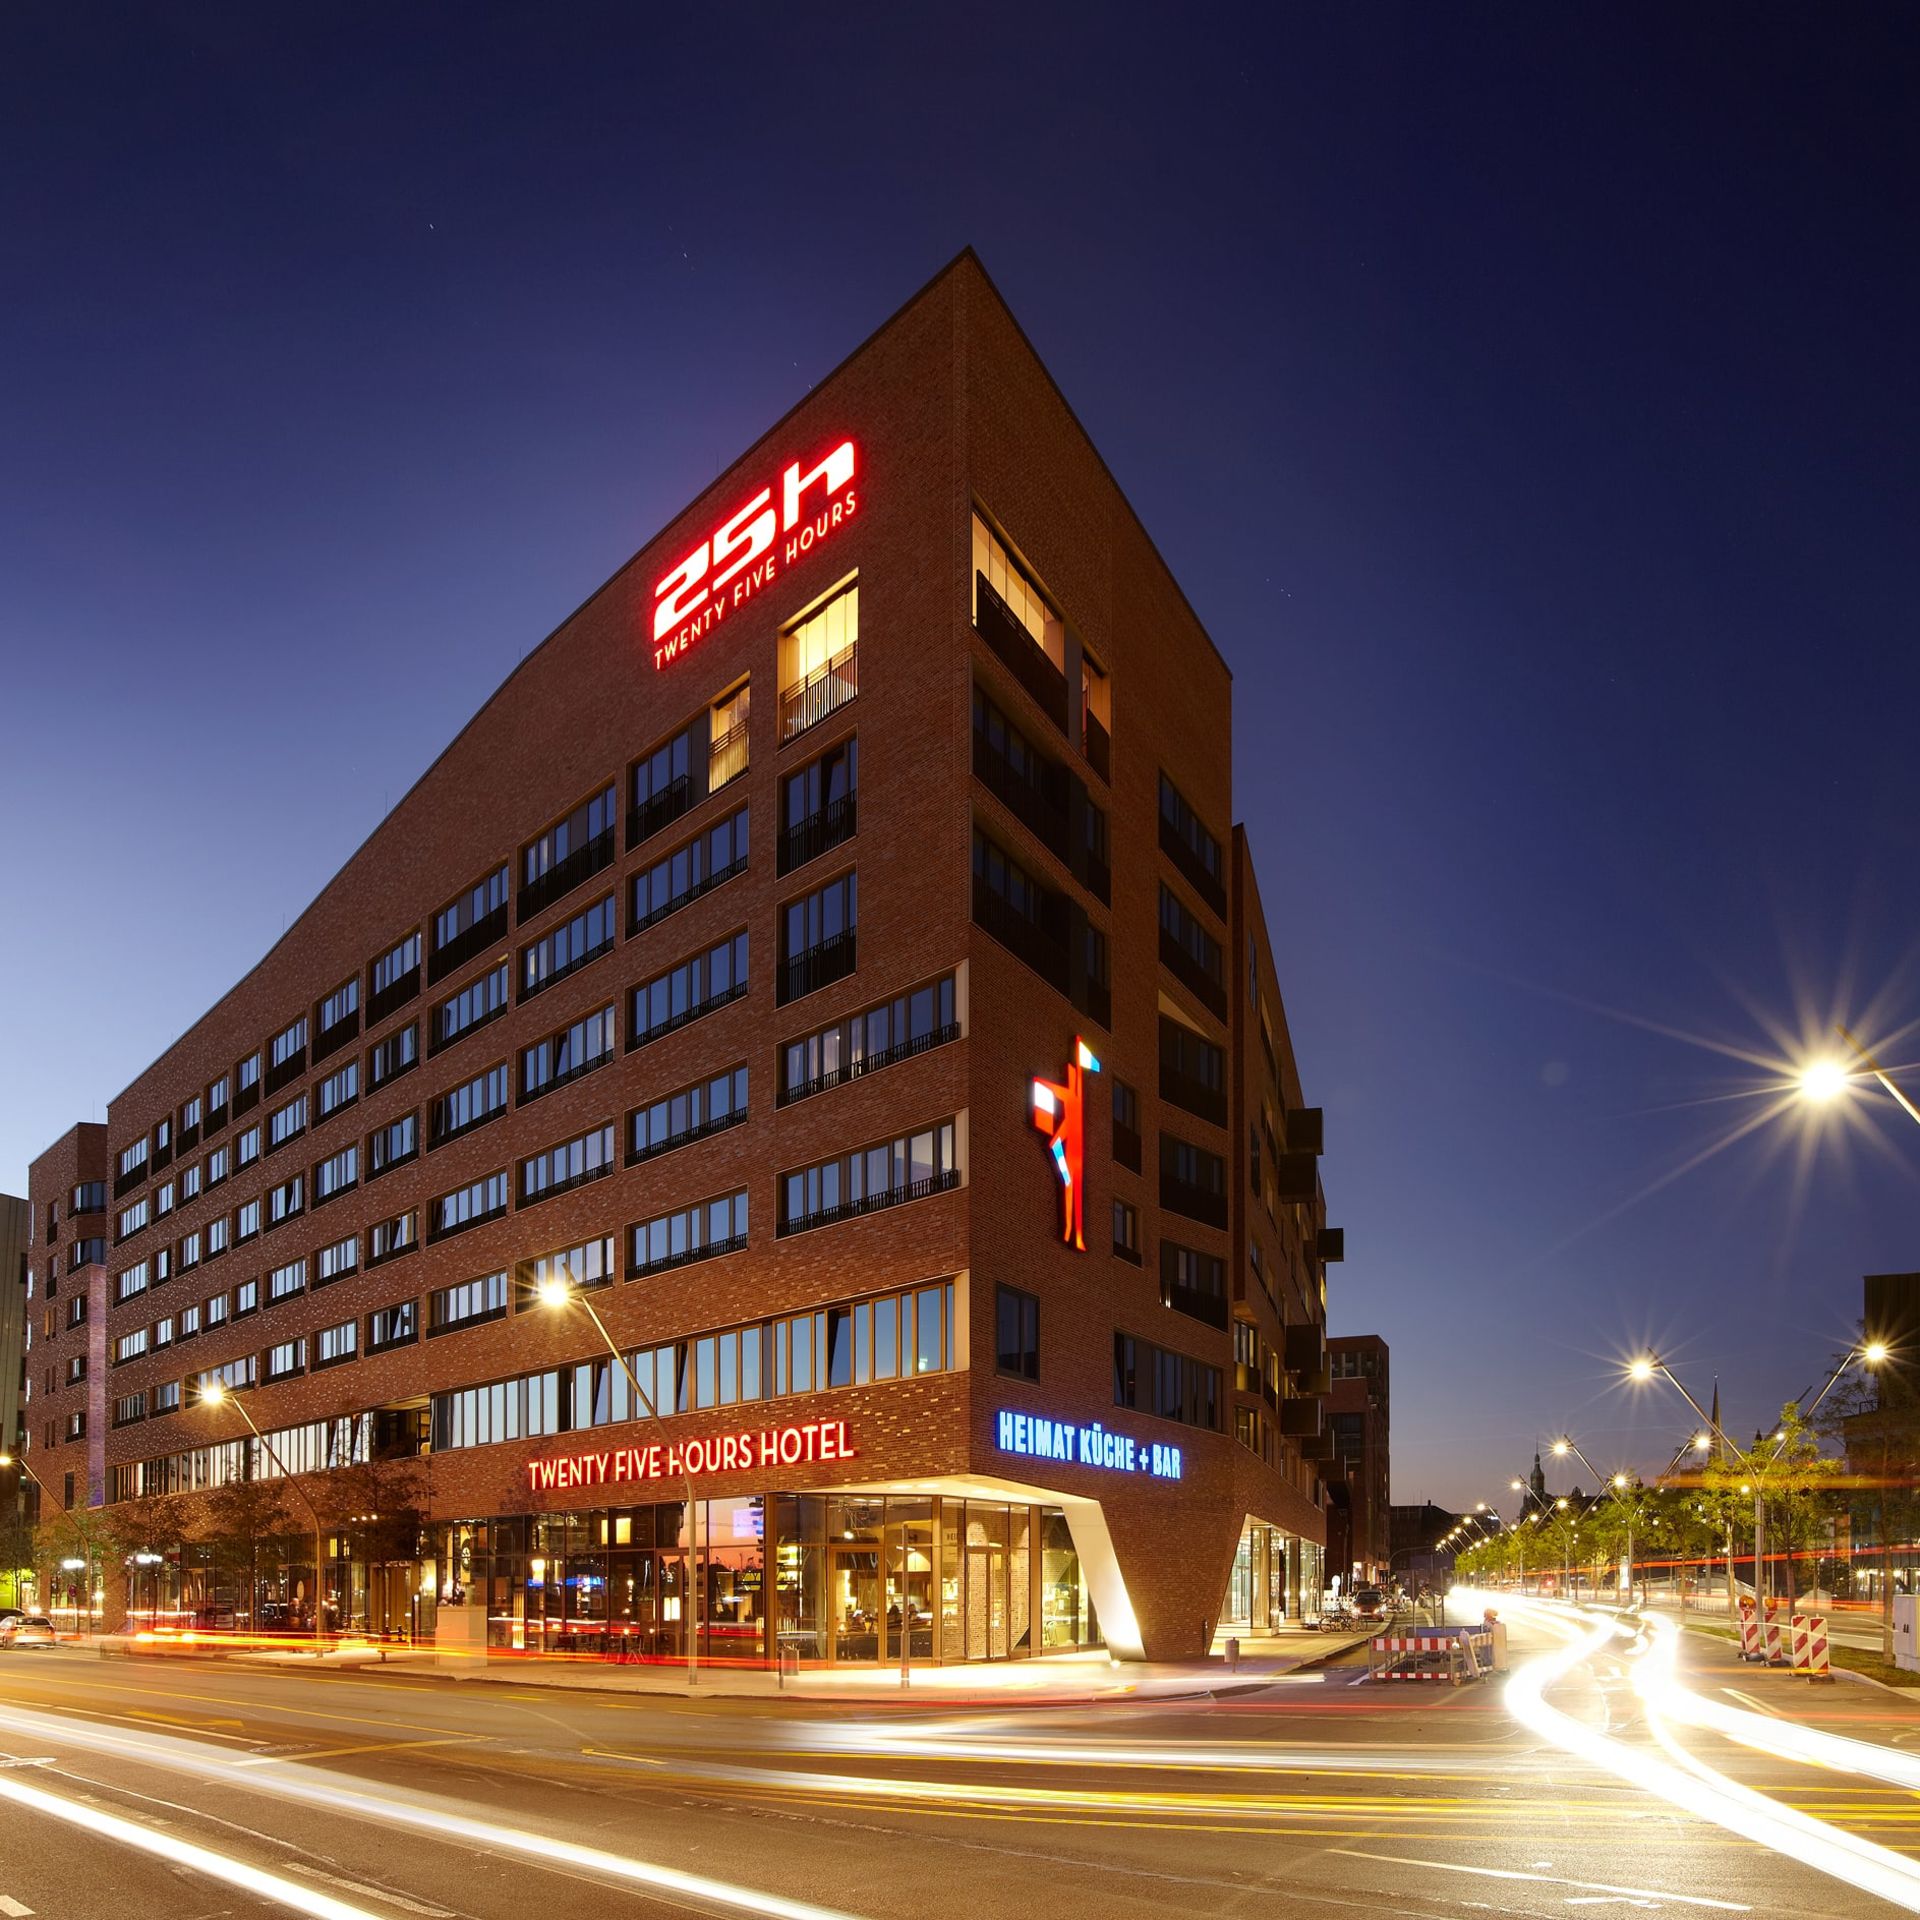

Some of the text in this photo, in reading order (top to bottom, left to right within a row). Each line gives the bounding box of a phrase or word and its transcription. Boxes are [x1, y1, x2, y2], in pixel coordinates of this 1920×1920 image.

[653, 441, 855, 642] 25h
[654, 491, 856, 669] TWENTY FIVE HOURS
[528, 1420, 854, 1490] TWENTY FIVE HOURS HOTEL
[999, 1411, 1181, 1479] HEIMAT KÜCHE + BAR
